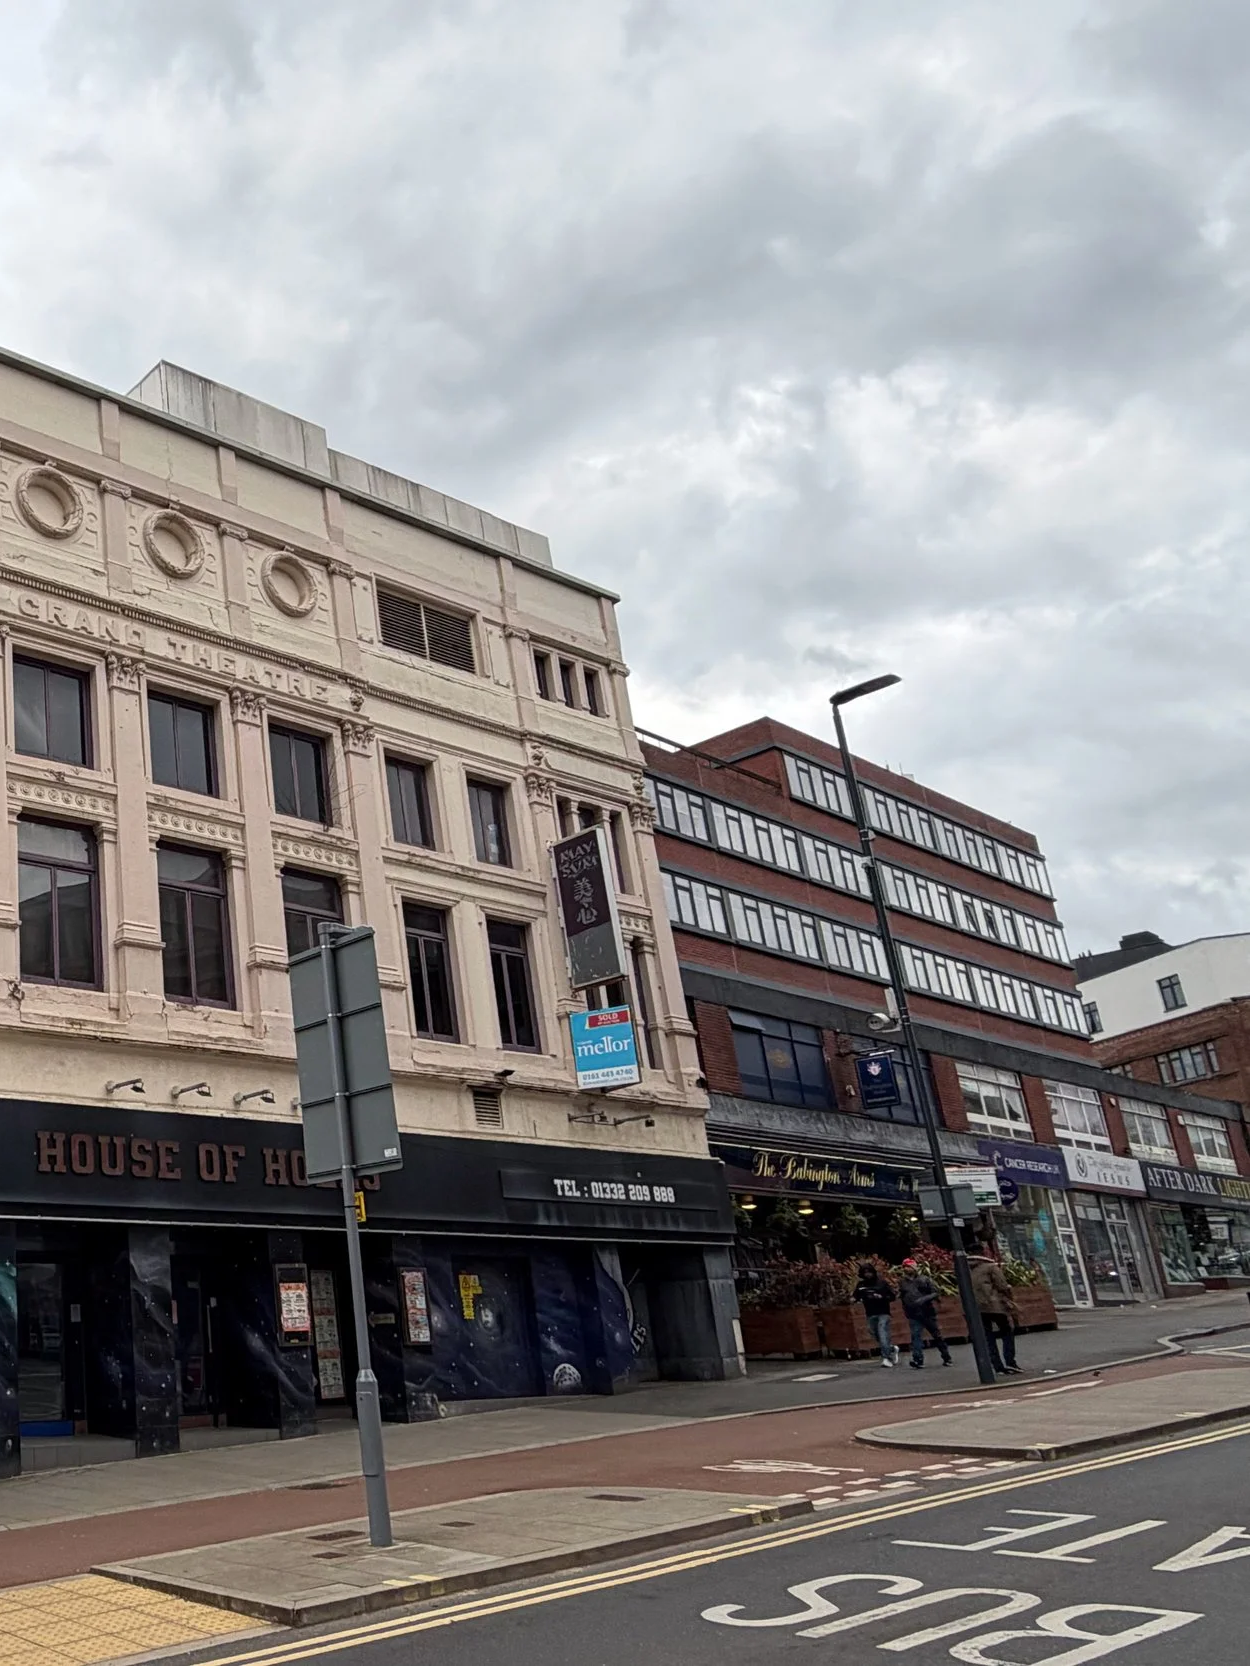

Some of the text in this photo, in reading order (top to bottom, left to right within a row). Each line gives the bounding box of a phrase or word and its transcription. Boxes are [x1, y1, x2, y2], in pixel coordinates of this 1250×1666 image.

[17, 598, 329, 704] GRAND THEATRE
[598, 1013, 618, 1021] SOLD
[577, 1035, 632, 1057] mellor
[36, 1130, 182, 1181] HOUSE
[199, 1143, 245, 1183] OF
[1004, 1157, 1026, 1169] CANCER
[751, 1151, 875, 1191] The Babington Arms
[1147, 1167, 1185, 1191] AFTER
[1183, 1172, 1218, 1195] DARK
[553, 1178, 581, 1197] TEL
[590, 1181, 626, 1200] 01332
[628, 1184, 651, 1201] 209
[652, 1186, 676, 1203] 888
[700, 1573, 1205, 1666] BUS
